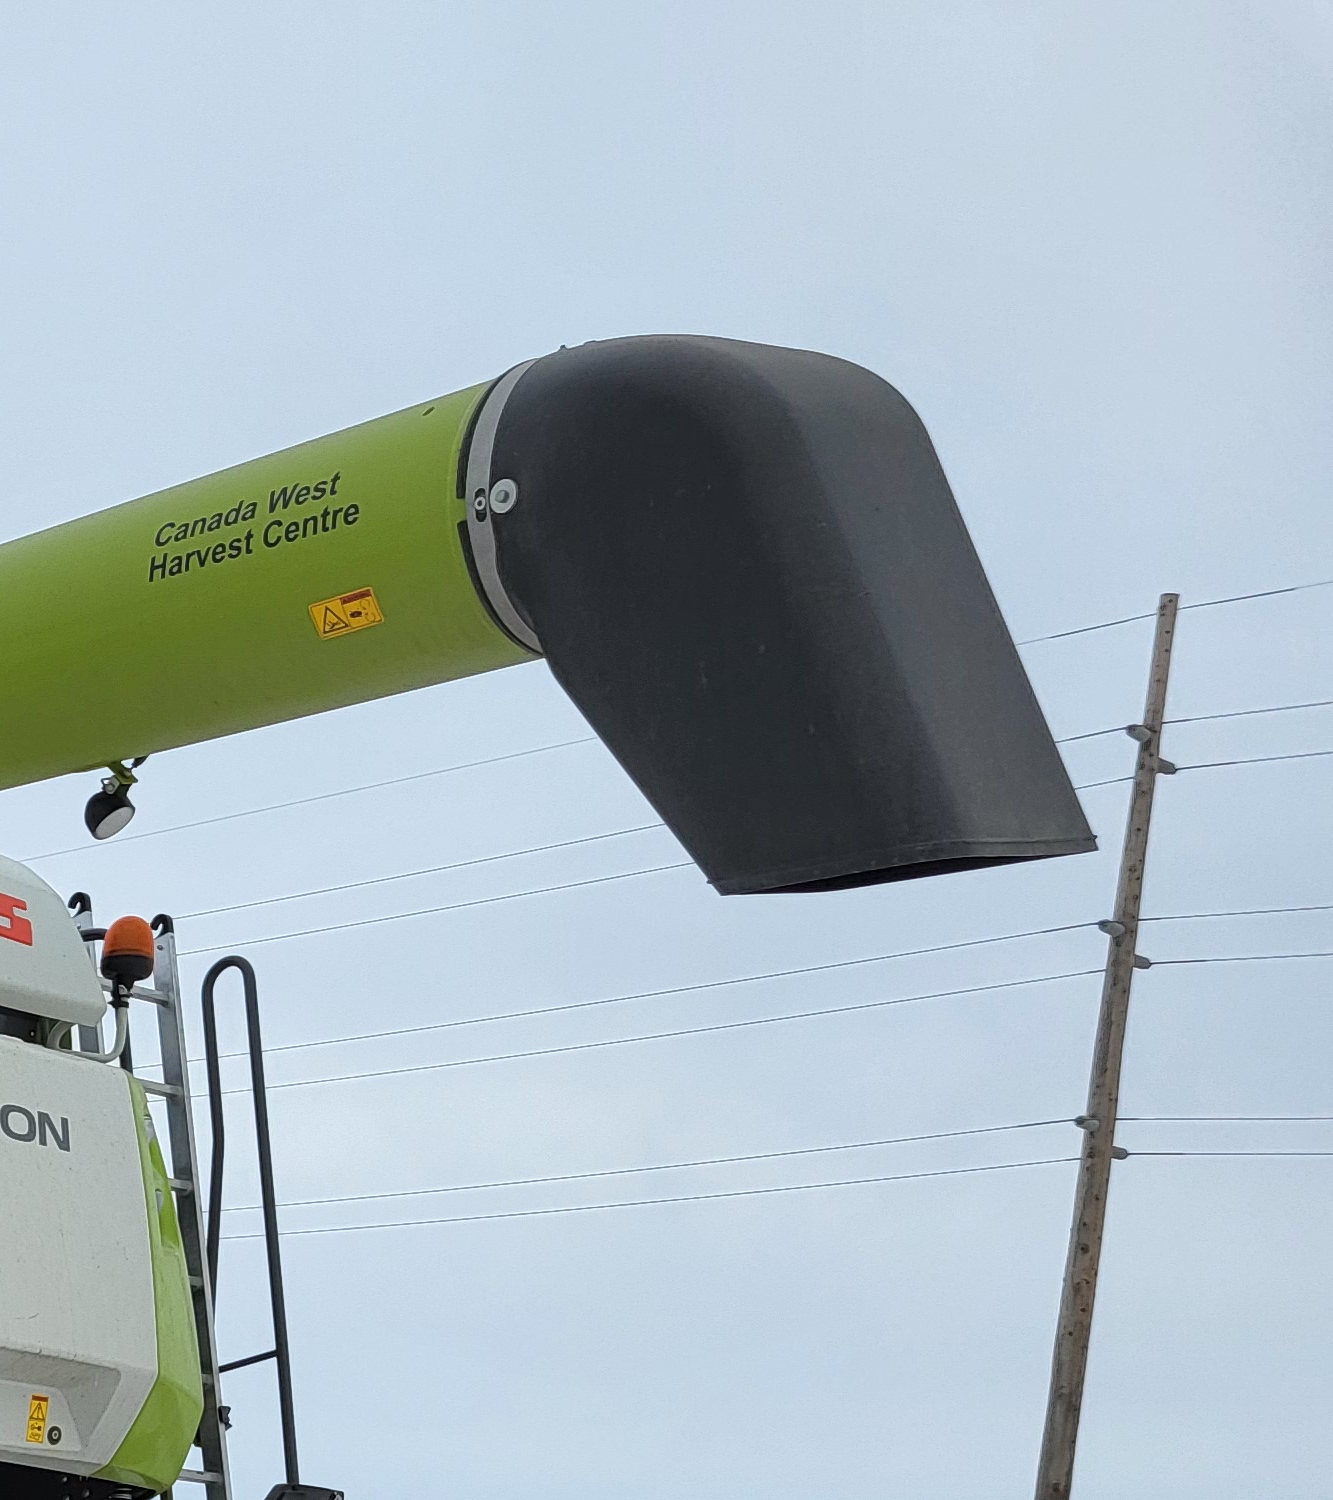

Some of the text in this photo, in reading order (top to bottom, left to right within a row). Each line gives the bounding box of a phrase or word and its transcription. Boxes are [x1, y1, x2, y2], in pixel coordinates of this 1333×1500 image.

[148, 503, 360, 583] Harvest Centre
[154, 471, 341, 547] Canada West
